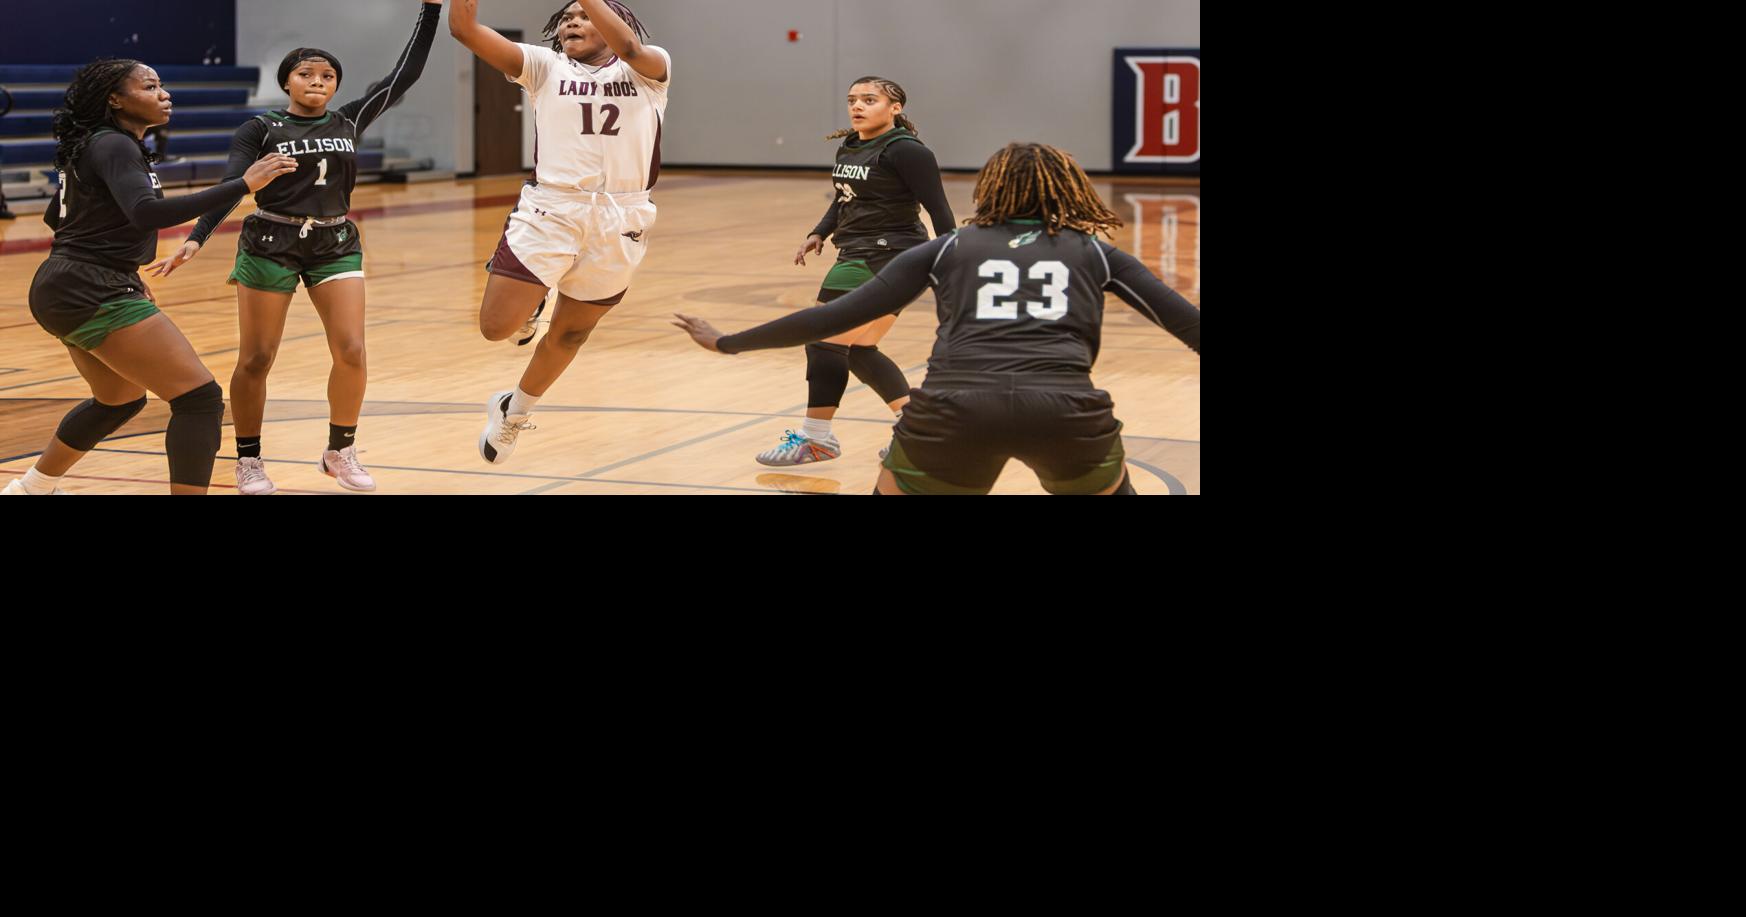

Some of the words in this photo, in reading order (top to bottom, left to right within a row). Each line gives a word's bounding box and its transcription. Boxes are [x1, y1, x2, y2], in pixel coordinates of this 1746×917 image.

[558, 79, 598, 96] LADY
[603, 80, 638, 97] ROOS
[578, 102, 621, 136] 12
[1123, 56, 1200, 163] B
[276, 137, 355, 157] ELLISON
[314, 157, 328, 186] 1
[832, 163, 870, 181] LLISON
[976, 259, 1070, 321] 23
